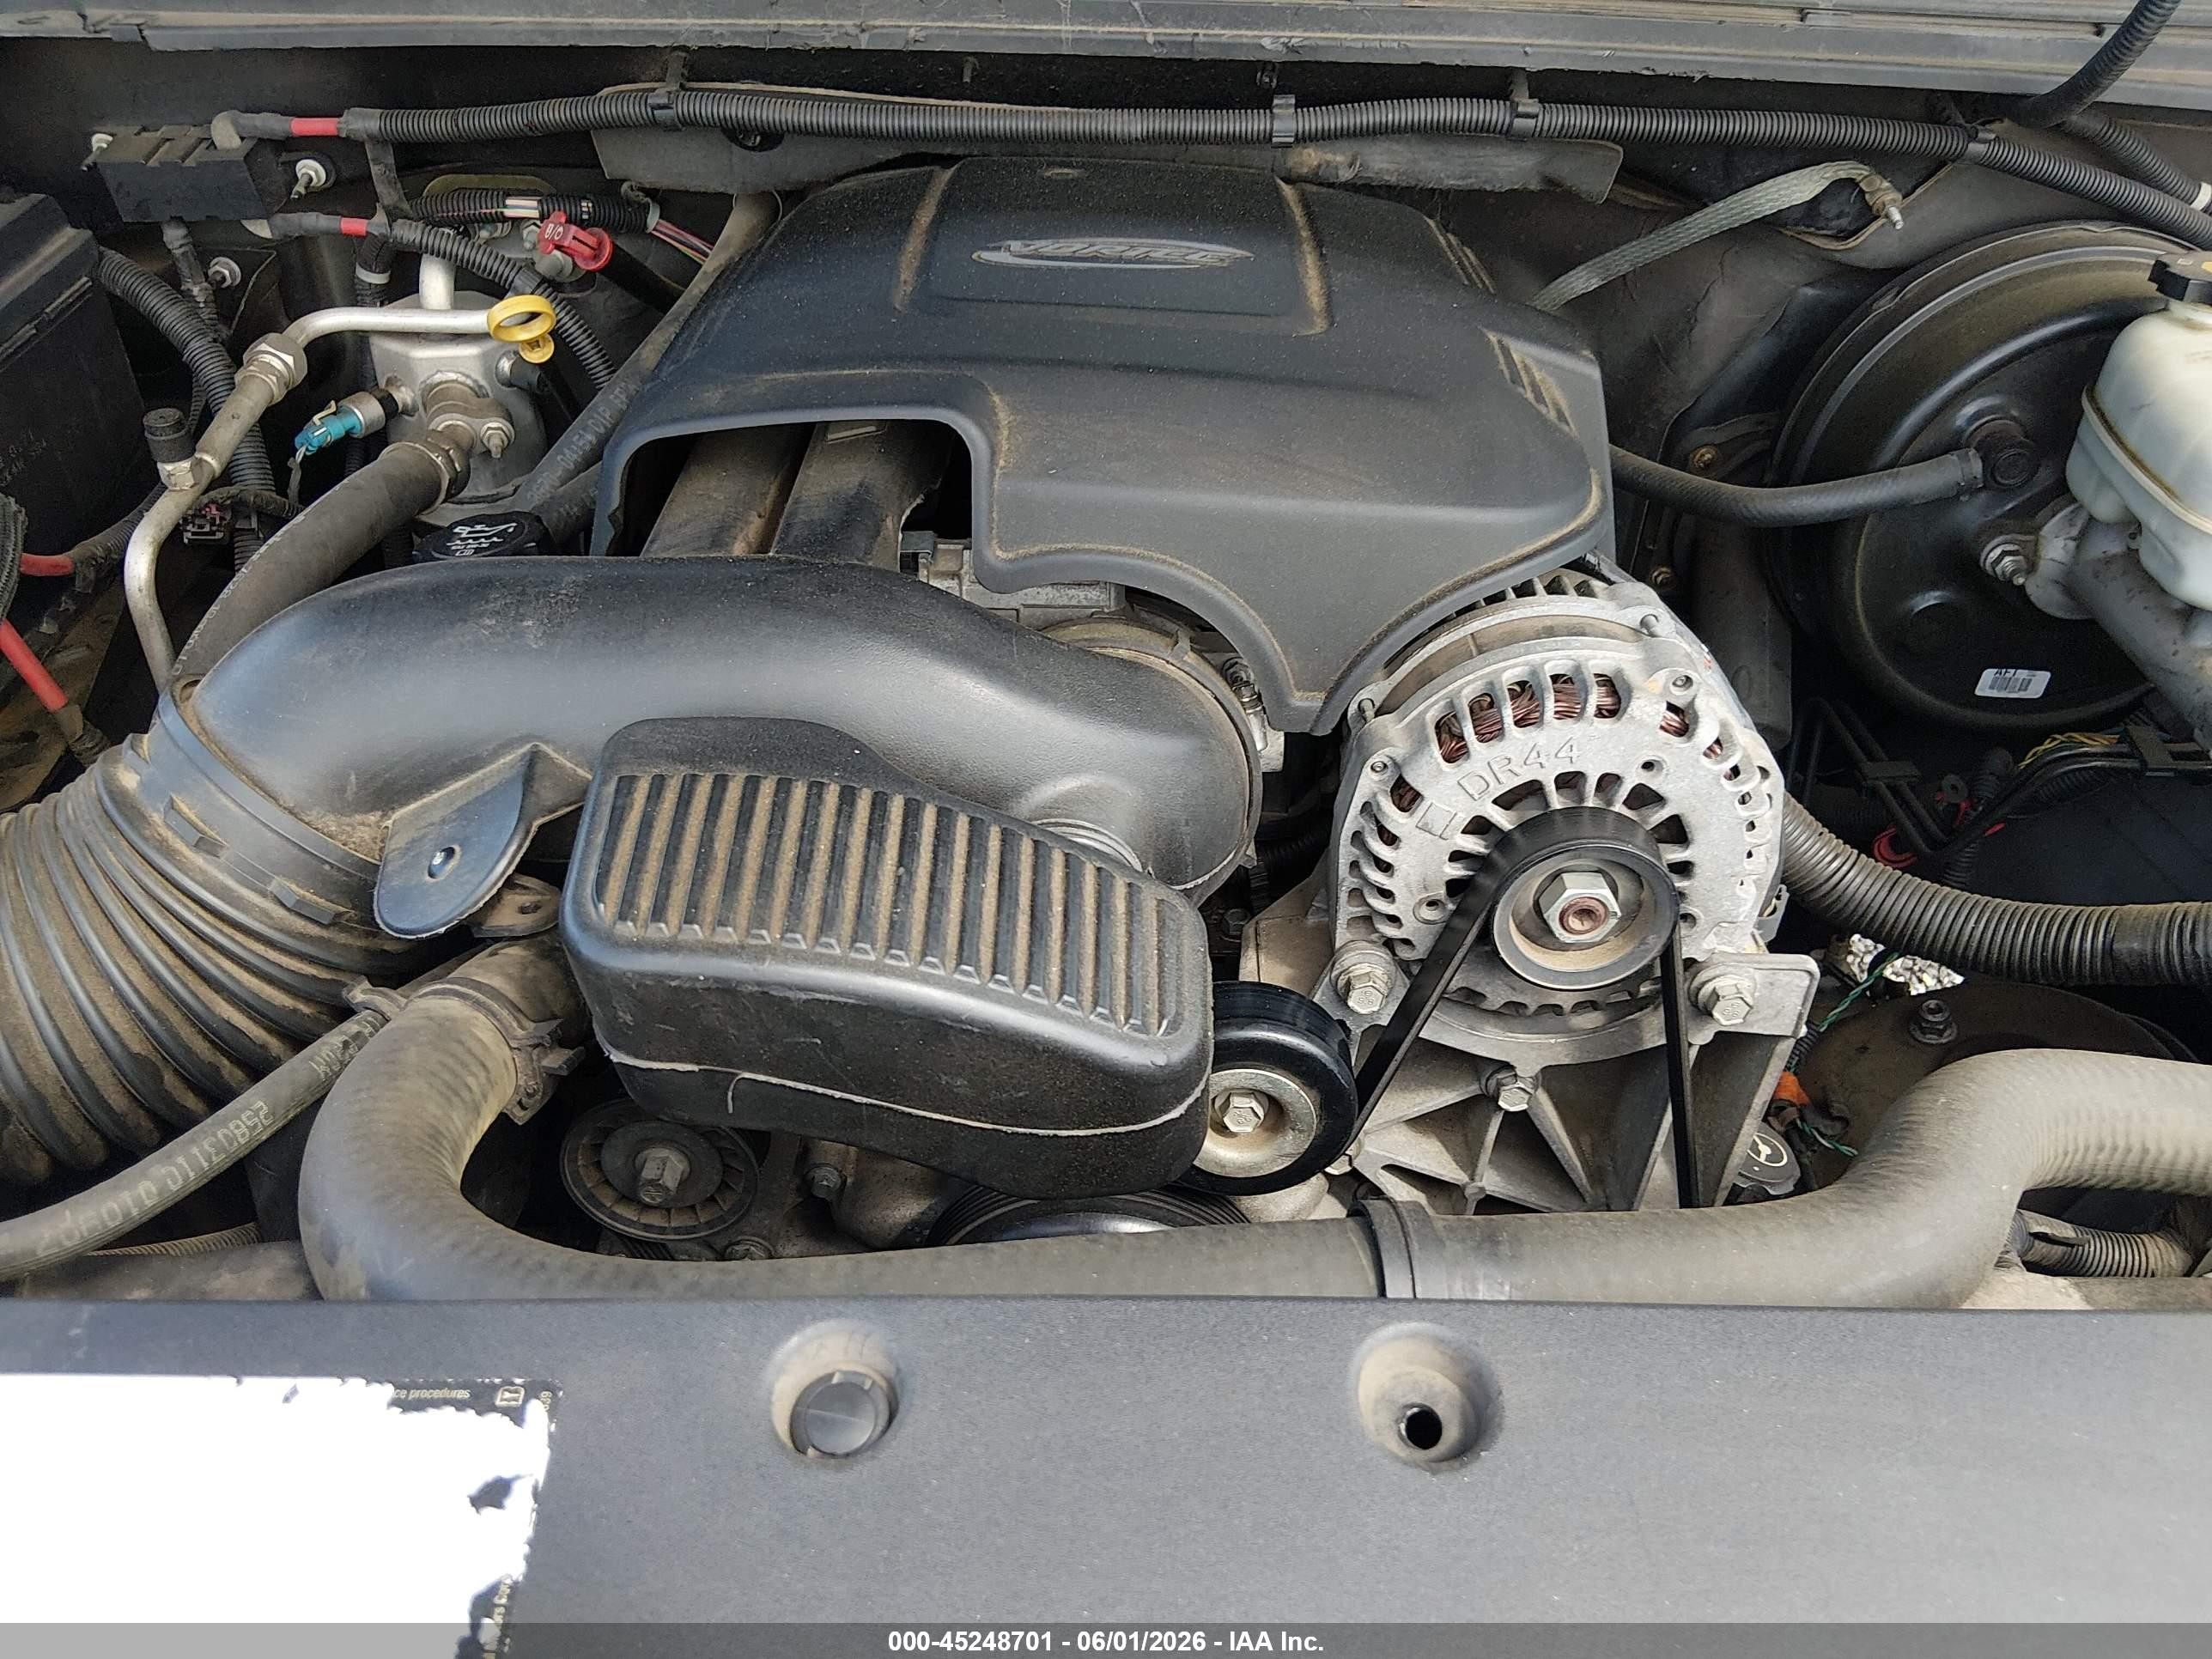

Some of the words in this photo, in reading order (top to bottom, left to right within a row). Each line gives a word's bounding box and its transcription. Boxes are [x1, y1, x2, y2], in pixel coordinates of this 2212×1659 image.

[1000, 240, 1233, 264] VORTEC
[1457, 736, 1582, 801] DR44
[408, 1388, 471, 1401] procedures
